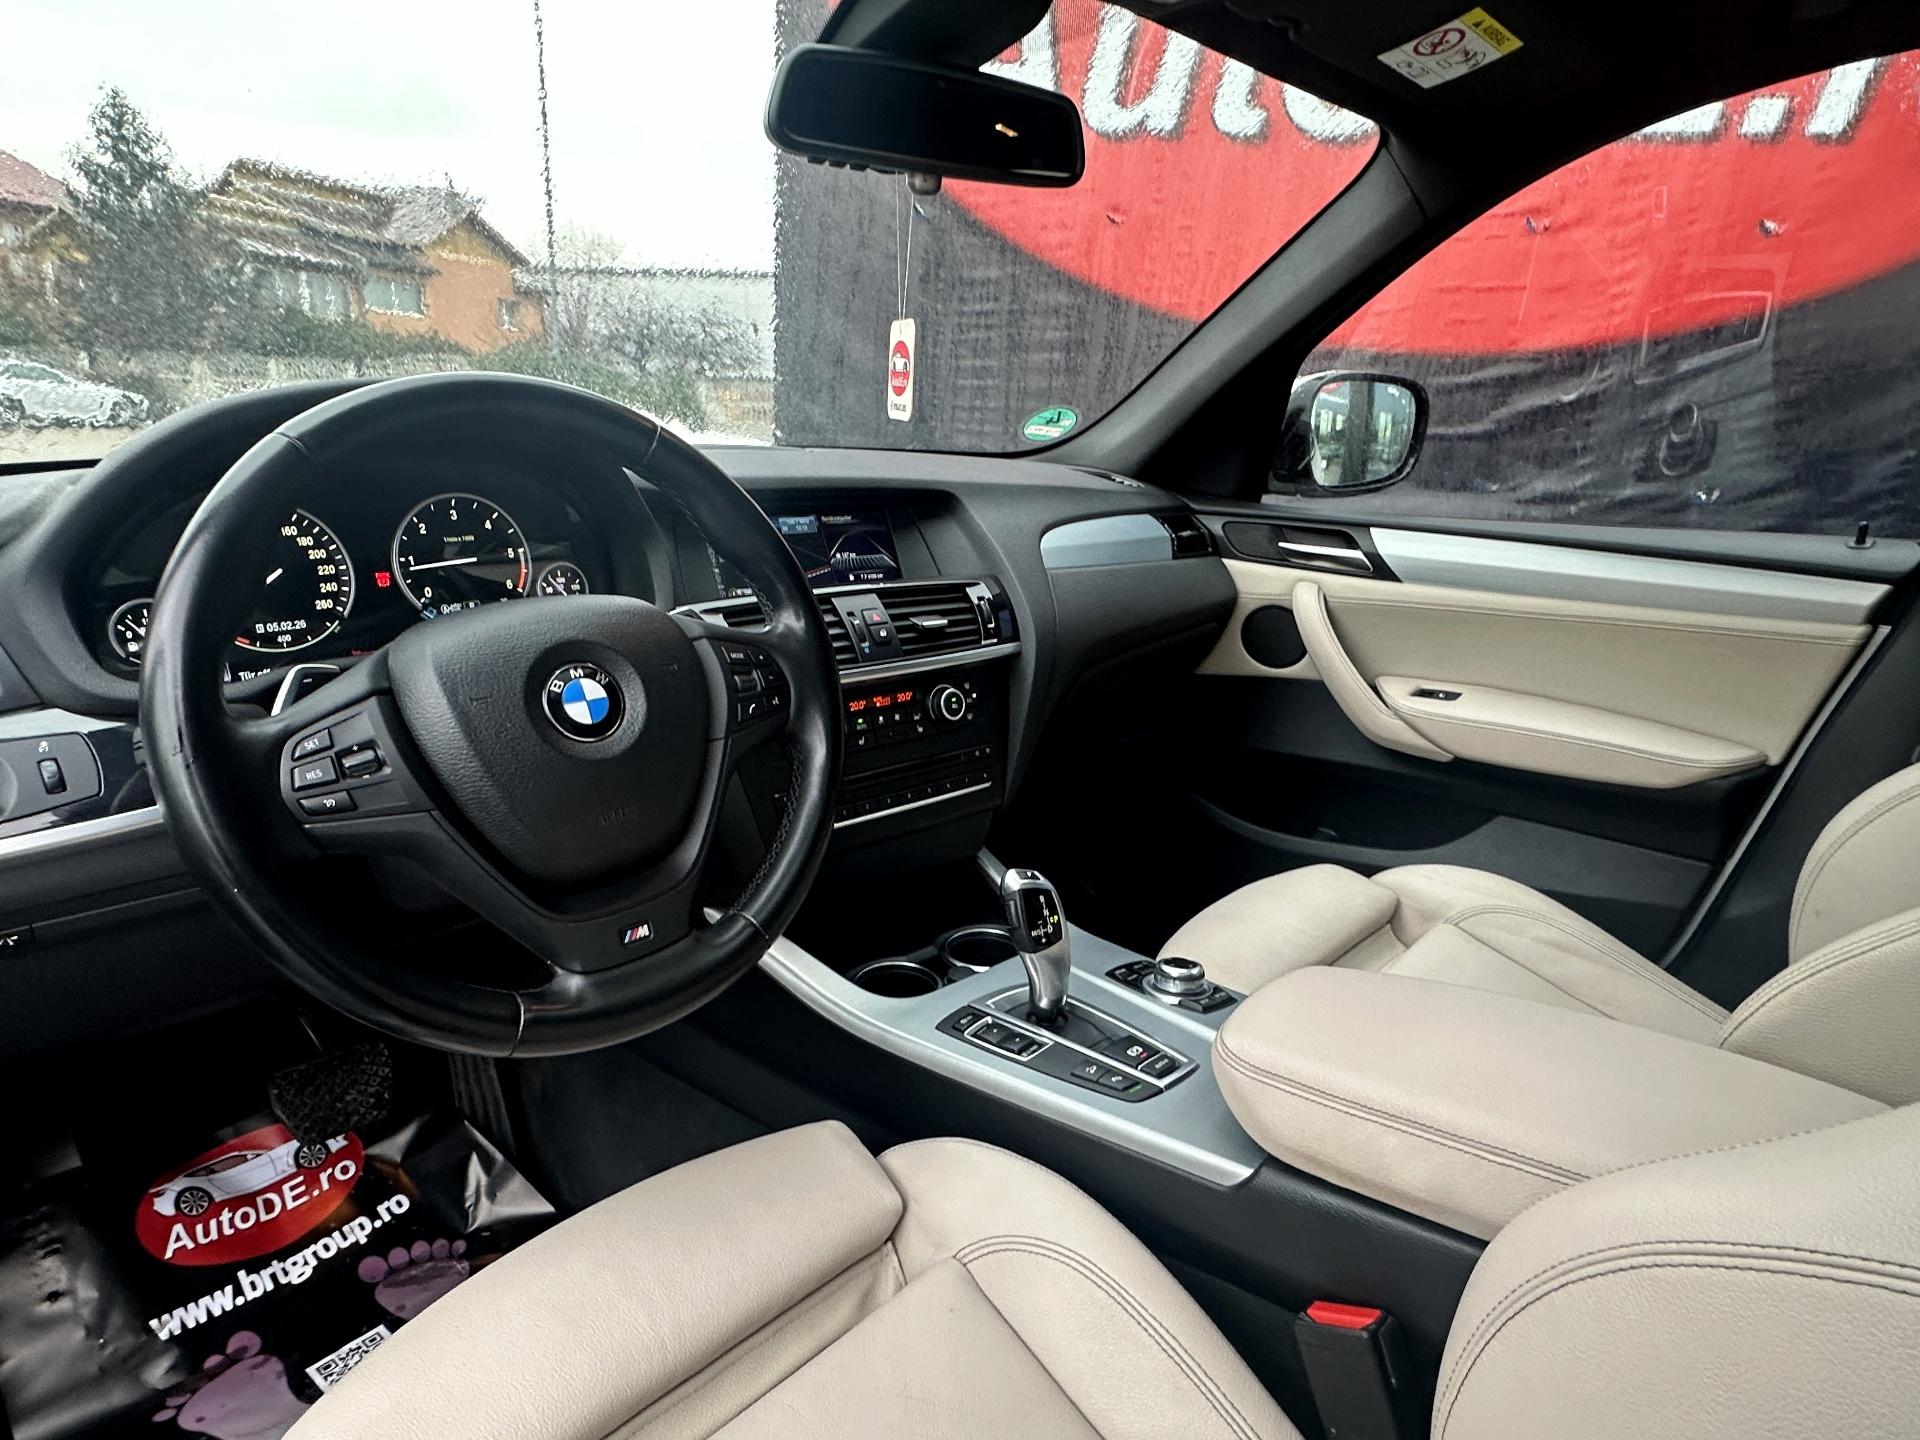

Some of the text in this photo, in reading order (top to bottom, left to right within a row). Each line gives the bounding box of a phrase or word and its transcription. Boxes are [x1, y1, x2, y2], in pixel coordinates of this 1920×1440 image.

[450, 509, 458, 520] 3
[418, 523, 427, 534] 2
[484, 519, 492, 530] 4
[281, 526, 298, 537] 160
[296, 536, 314, 547] 180
[308, 549, 327, 560] 200
[507, 548, 515, 559] 5
[408, 556, 415, 566] 1
[317, 564, 336, 576] 220
[319, 582, 338, 593] 240
[506, 579, 513, 590] 6
[424, 587, 433, 598] 0
[315, 599, 334, 610] 260
[549, 667, 609, 693] BMW
[304, 738, 320, 750] SET
[305, 769, 323, 780] RES
[164, 1159, 357, 1260] AutoDE.ro
[149, 1193, 411, 1342] www.brtgroup.ro
